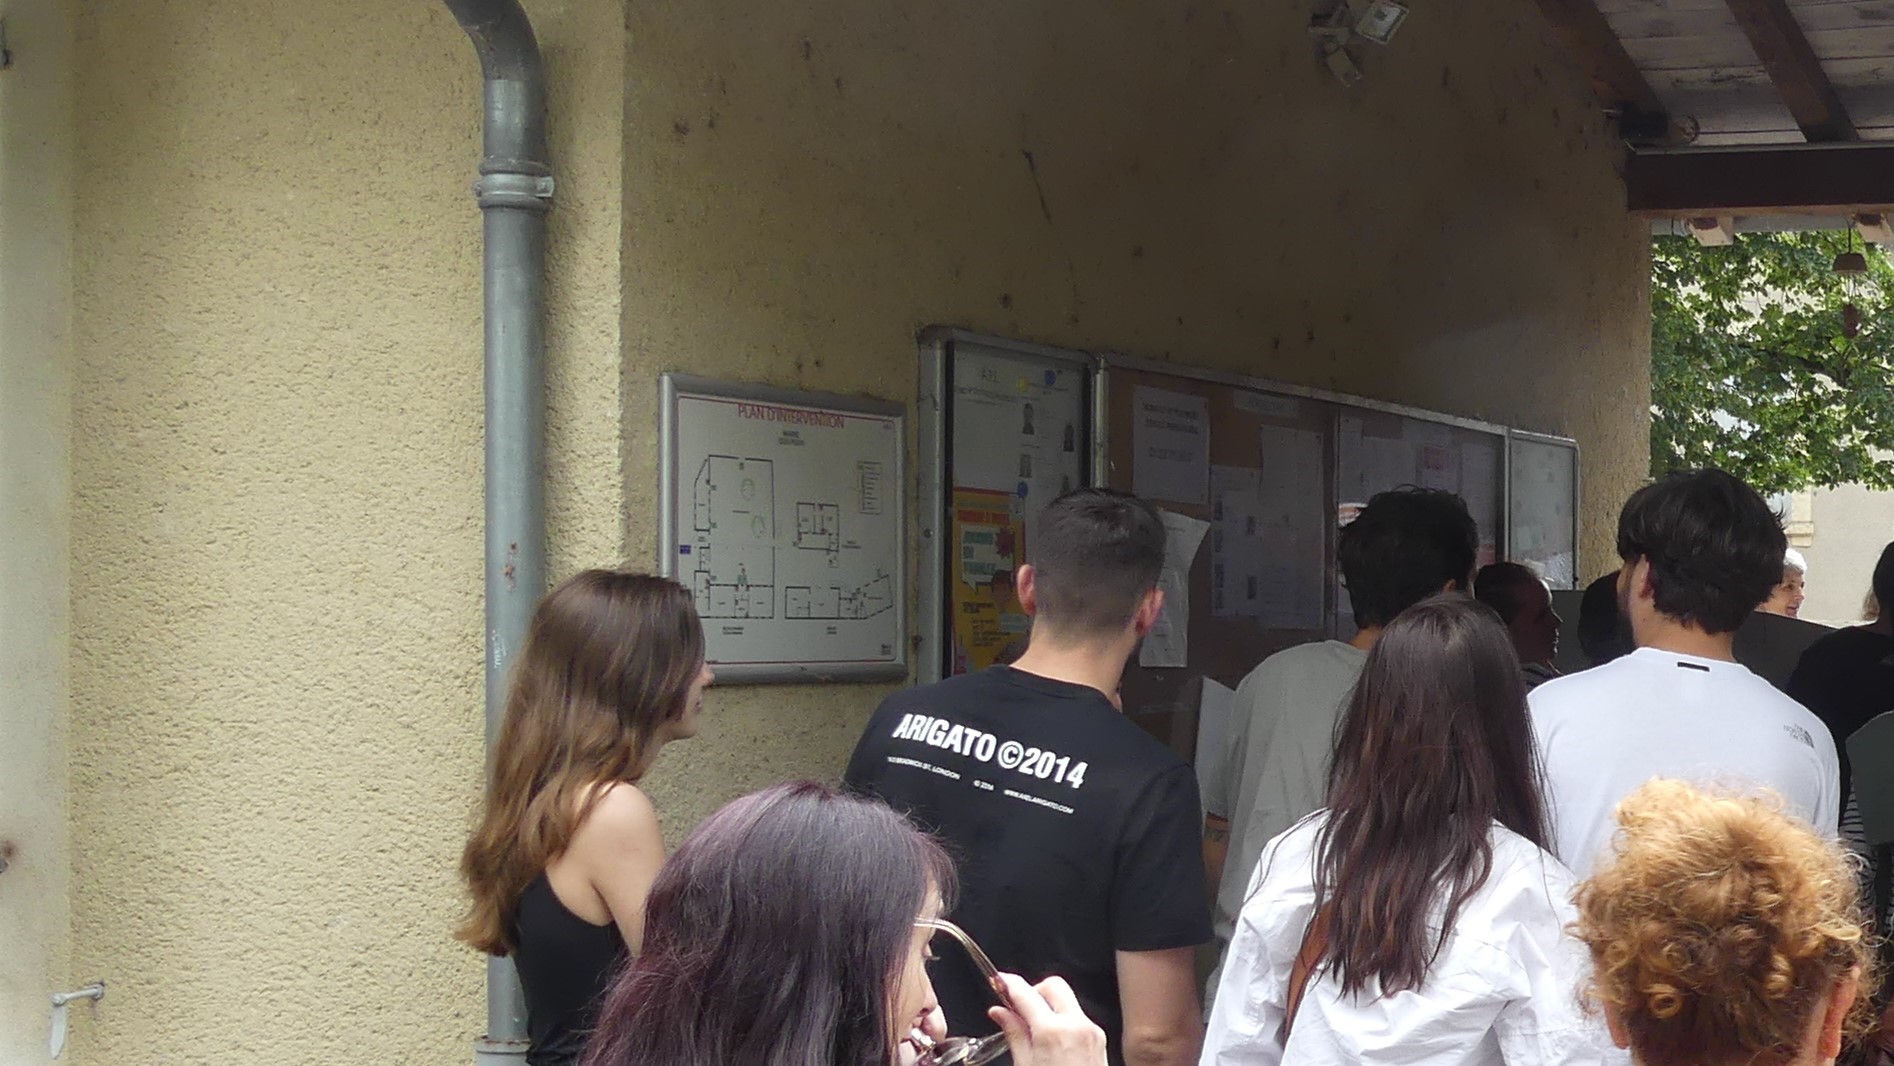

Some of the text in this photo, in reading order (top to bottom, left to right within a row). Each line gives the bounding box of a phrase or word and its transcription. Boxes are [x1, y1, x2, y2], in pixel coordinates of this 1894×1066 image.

[738, 404, 845, 428] PLAN D'INTERVENTION
[892, 713, 1089, 789] ARIGATO ©2014
